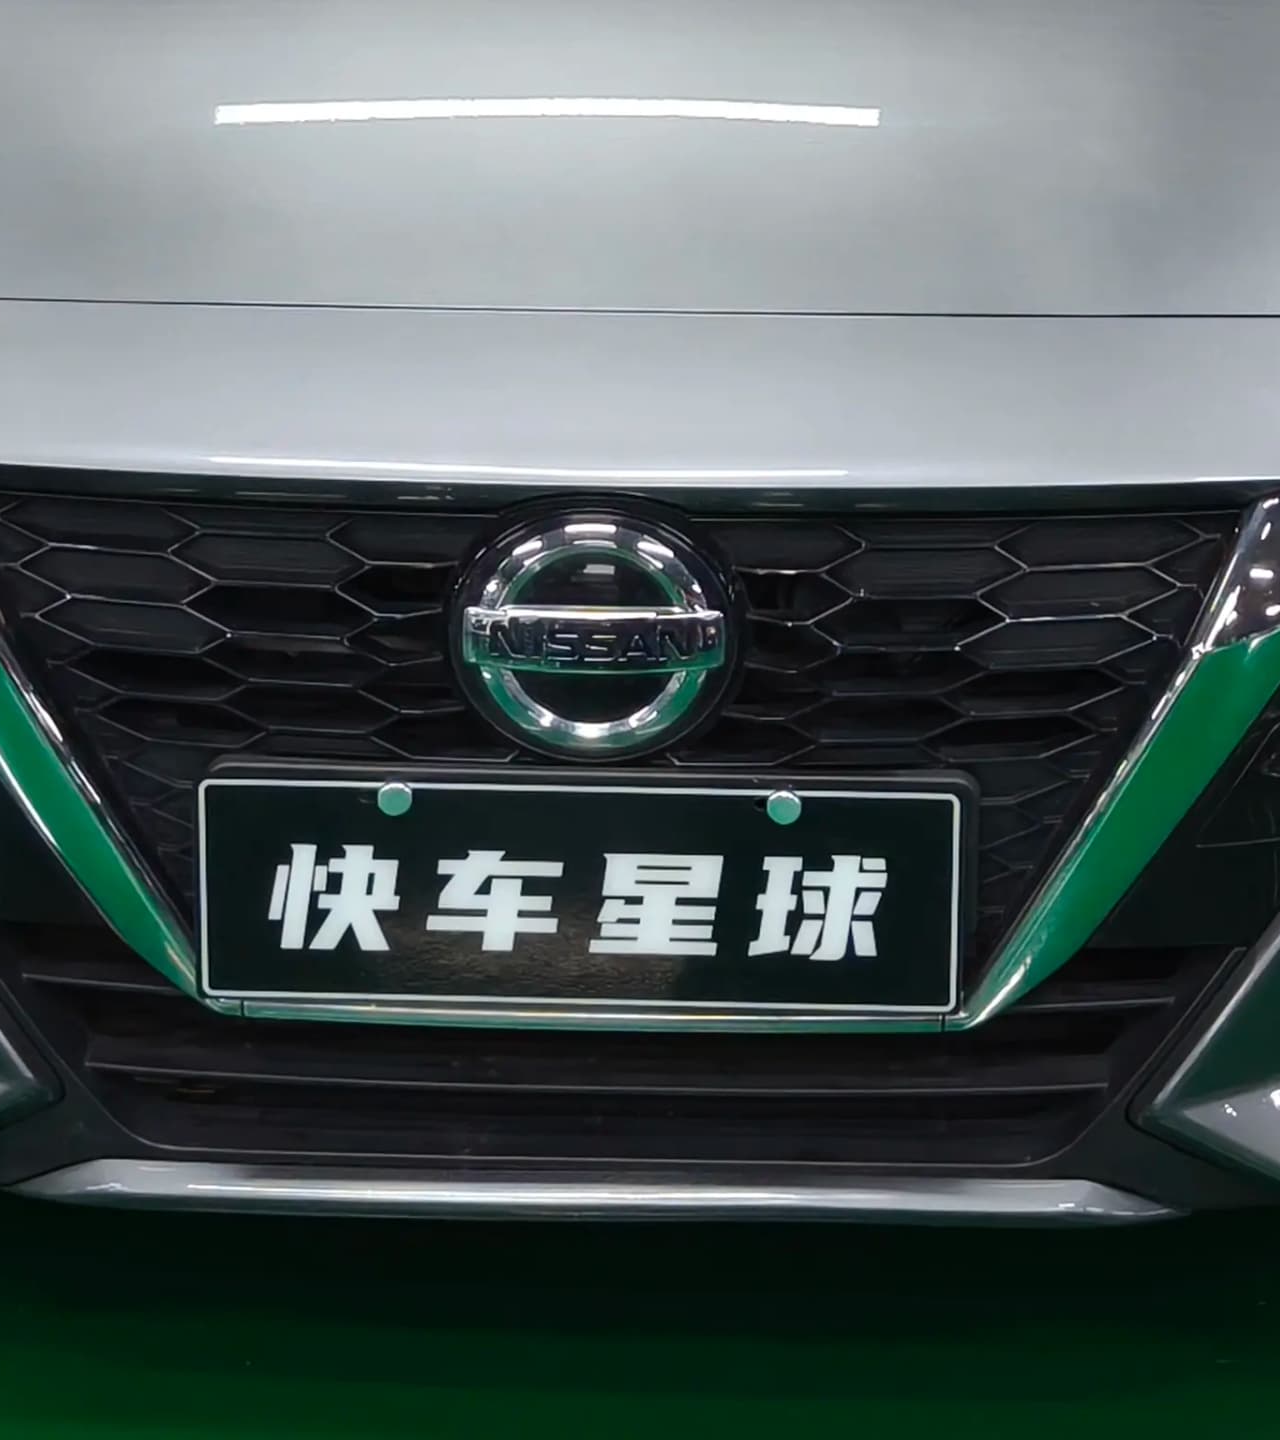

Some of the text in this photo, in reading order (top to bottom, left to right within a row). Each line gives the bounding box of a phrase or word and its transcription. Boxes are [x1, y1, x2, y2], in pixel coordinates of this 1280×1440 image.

[488, 618, 703, 664] NISSAN
[266, 843, 889, 962] 快车星球
